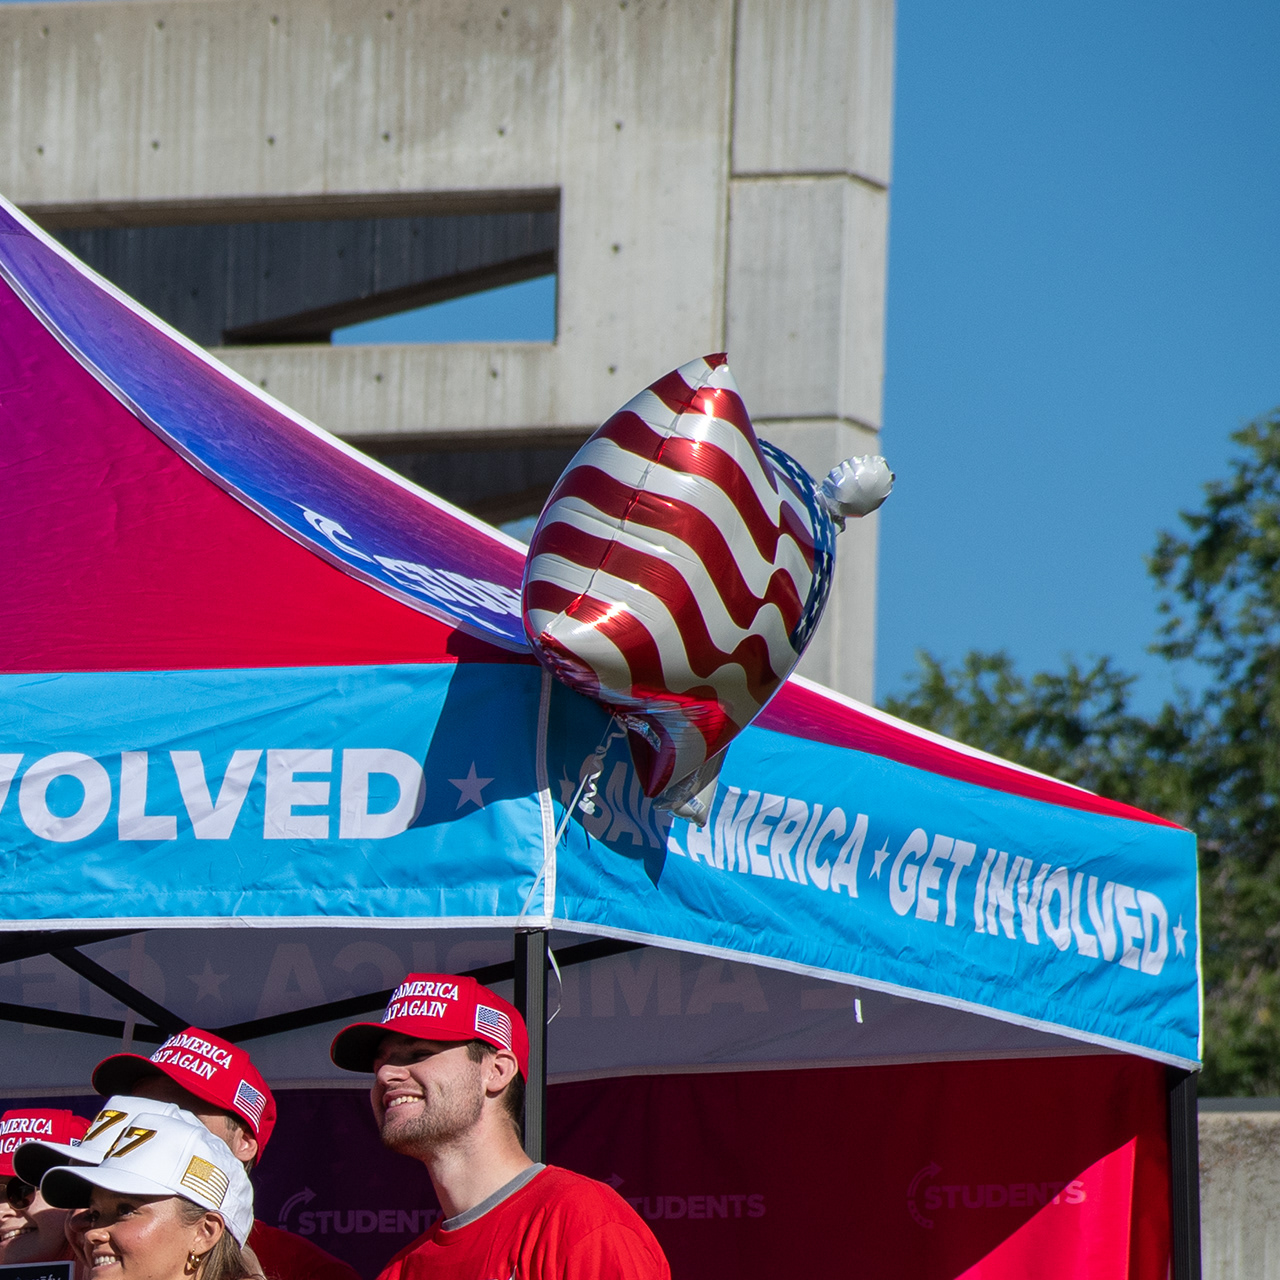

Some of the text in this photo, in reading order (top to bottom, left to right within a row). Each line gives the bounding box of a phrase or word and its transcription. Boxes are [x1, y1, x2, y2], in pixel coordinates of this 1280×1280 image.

[687, 786, 867, 898] AMERICA
[889, 827, 978, 926] GET
[975, 847, 1169, 976] INVOLVED
[396, 981, 459, 1002] AMERICA
[397, 1001, 447, 1019] AGAIN
[167, 1051, 218, 1080] AGAIN
[175, 1034, 233, 1070] AMERICA
[635, 1193, 767, 1221] TUDENTS
[925, 1180, 1087, 1210] STUDENTS
